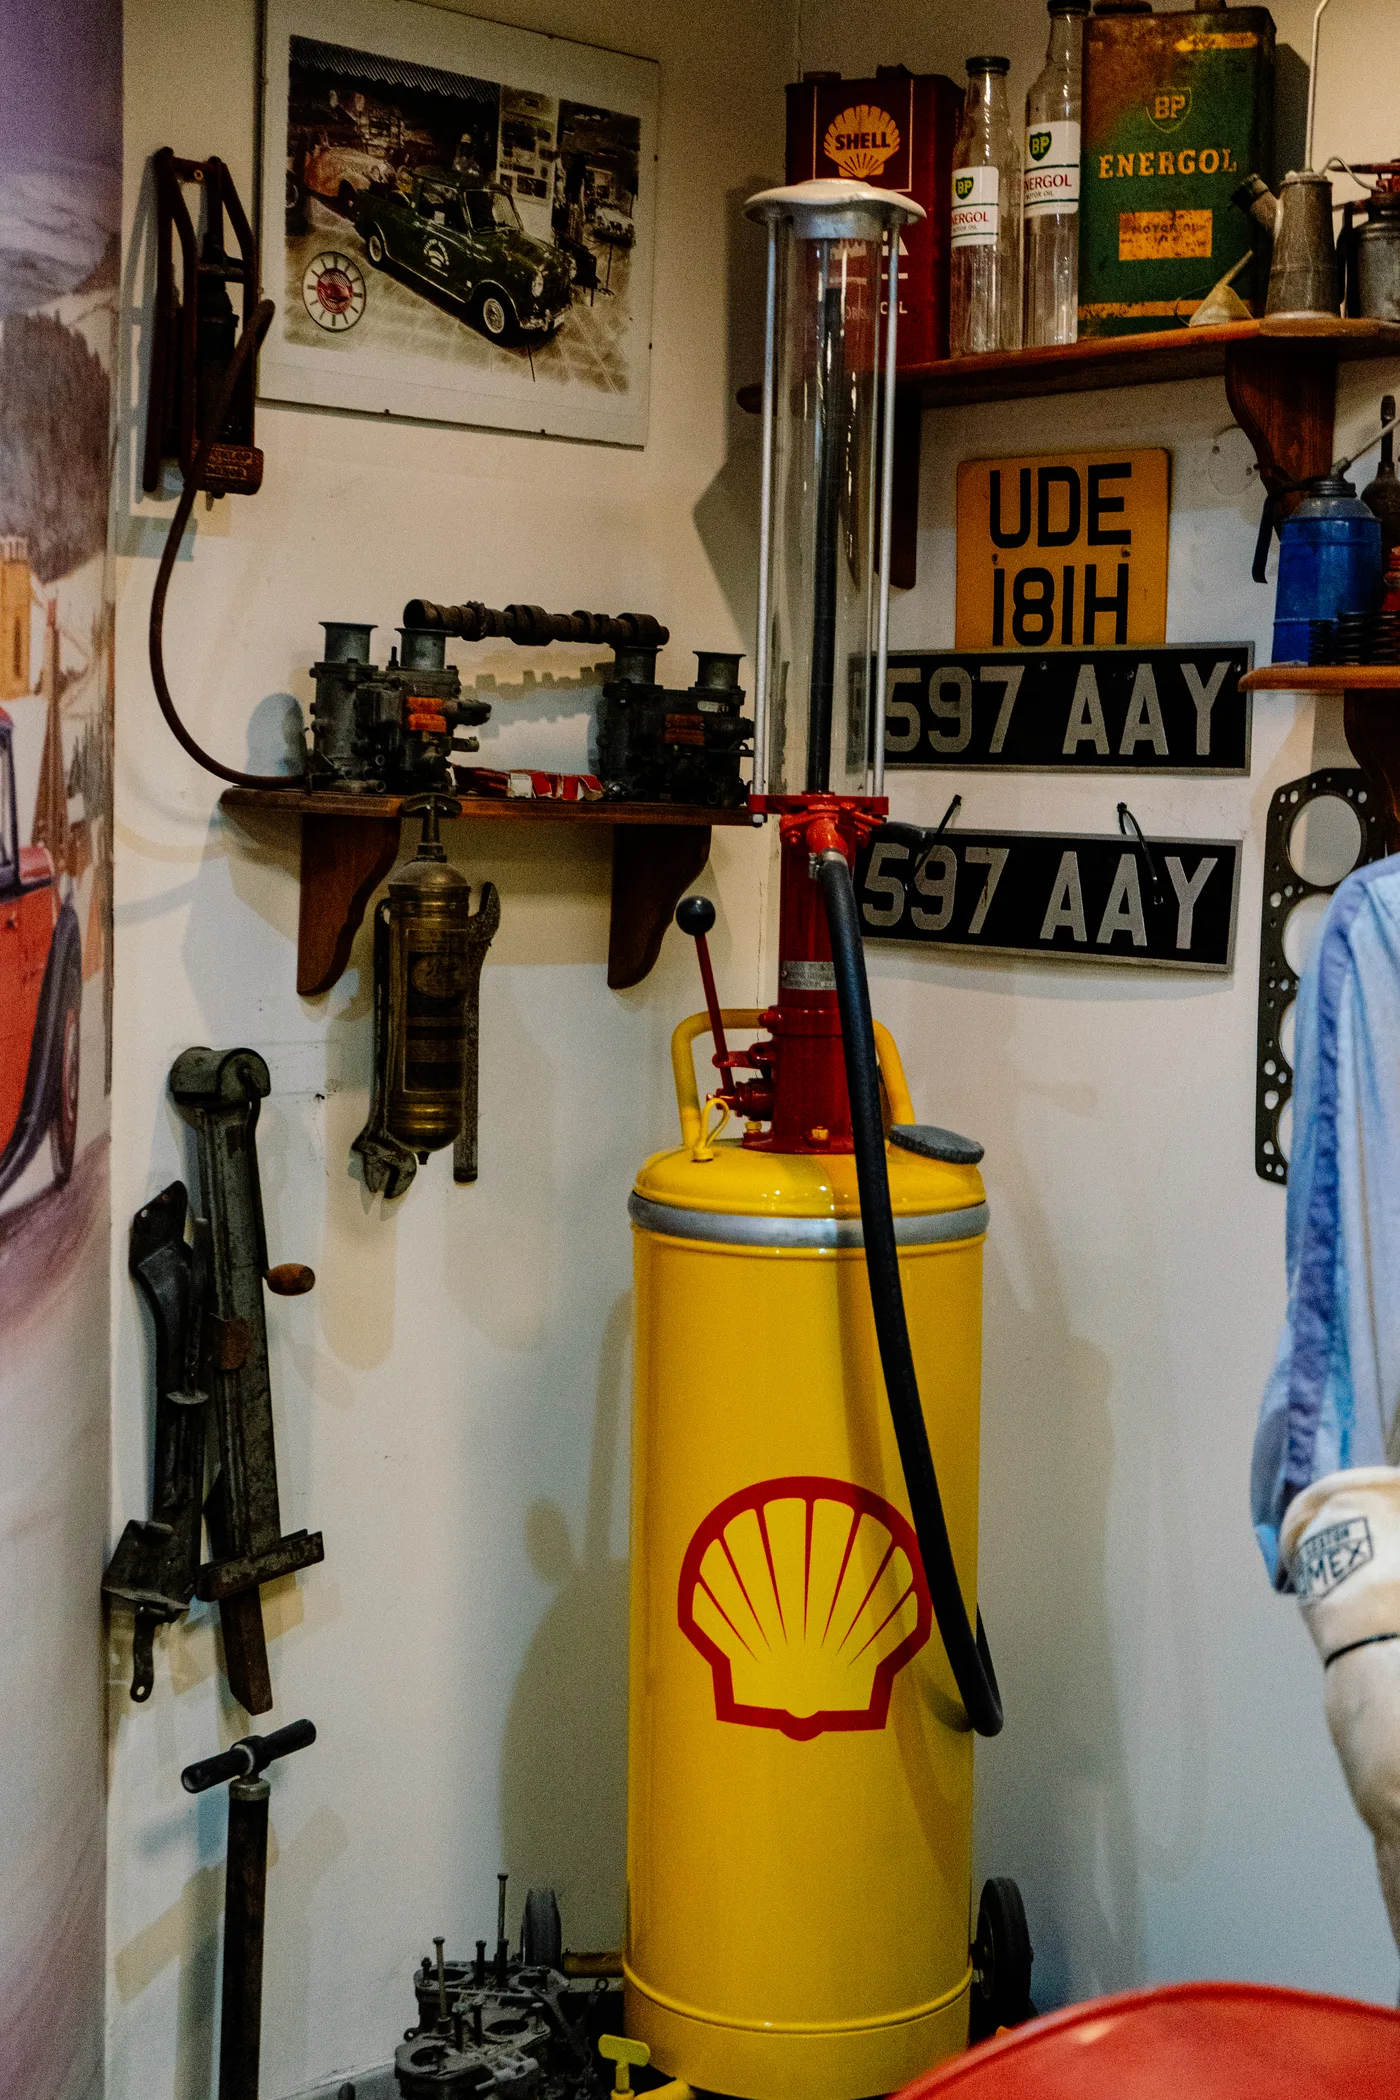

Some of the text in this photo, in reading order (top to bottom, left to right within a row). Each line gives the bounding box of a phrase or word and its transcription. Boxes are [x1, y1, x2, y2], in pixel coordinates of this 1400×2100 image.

[1155, 95, 1186, 119] BP
[835, 131, 891, 151] SHELL
[1032, 136, 1050, 154] BP
[1098, 148, 1238, 179] ENERGOL
[958, 182, 972, 194] BP
[989, 462, 1132, 549] UDE
[992, 563, 1129, 647] 181H
[885, 661, 1231, 756] 597 AAY
[862, 842, 1218, 950] 597 AAY
